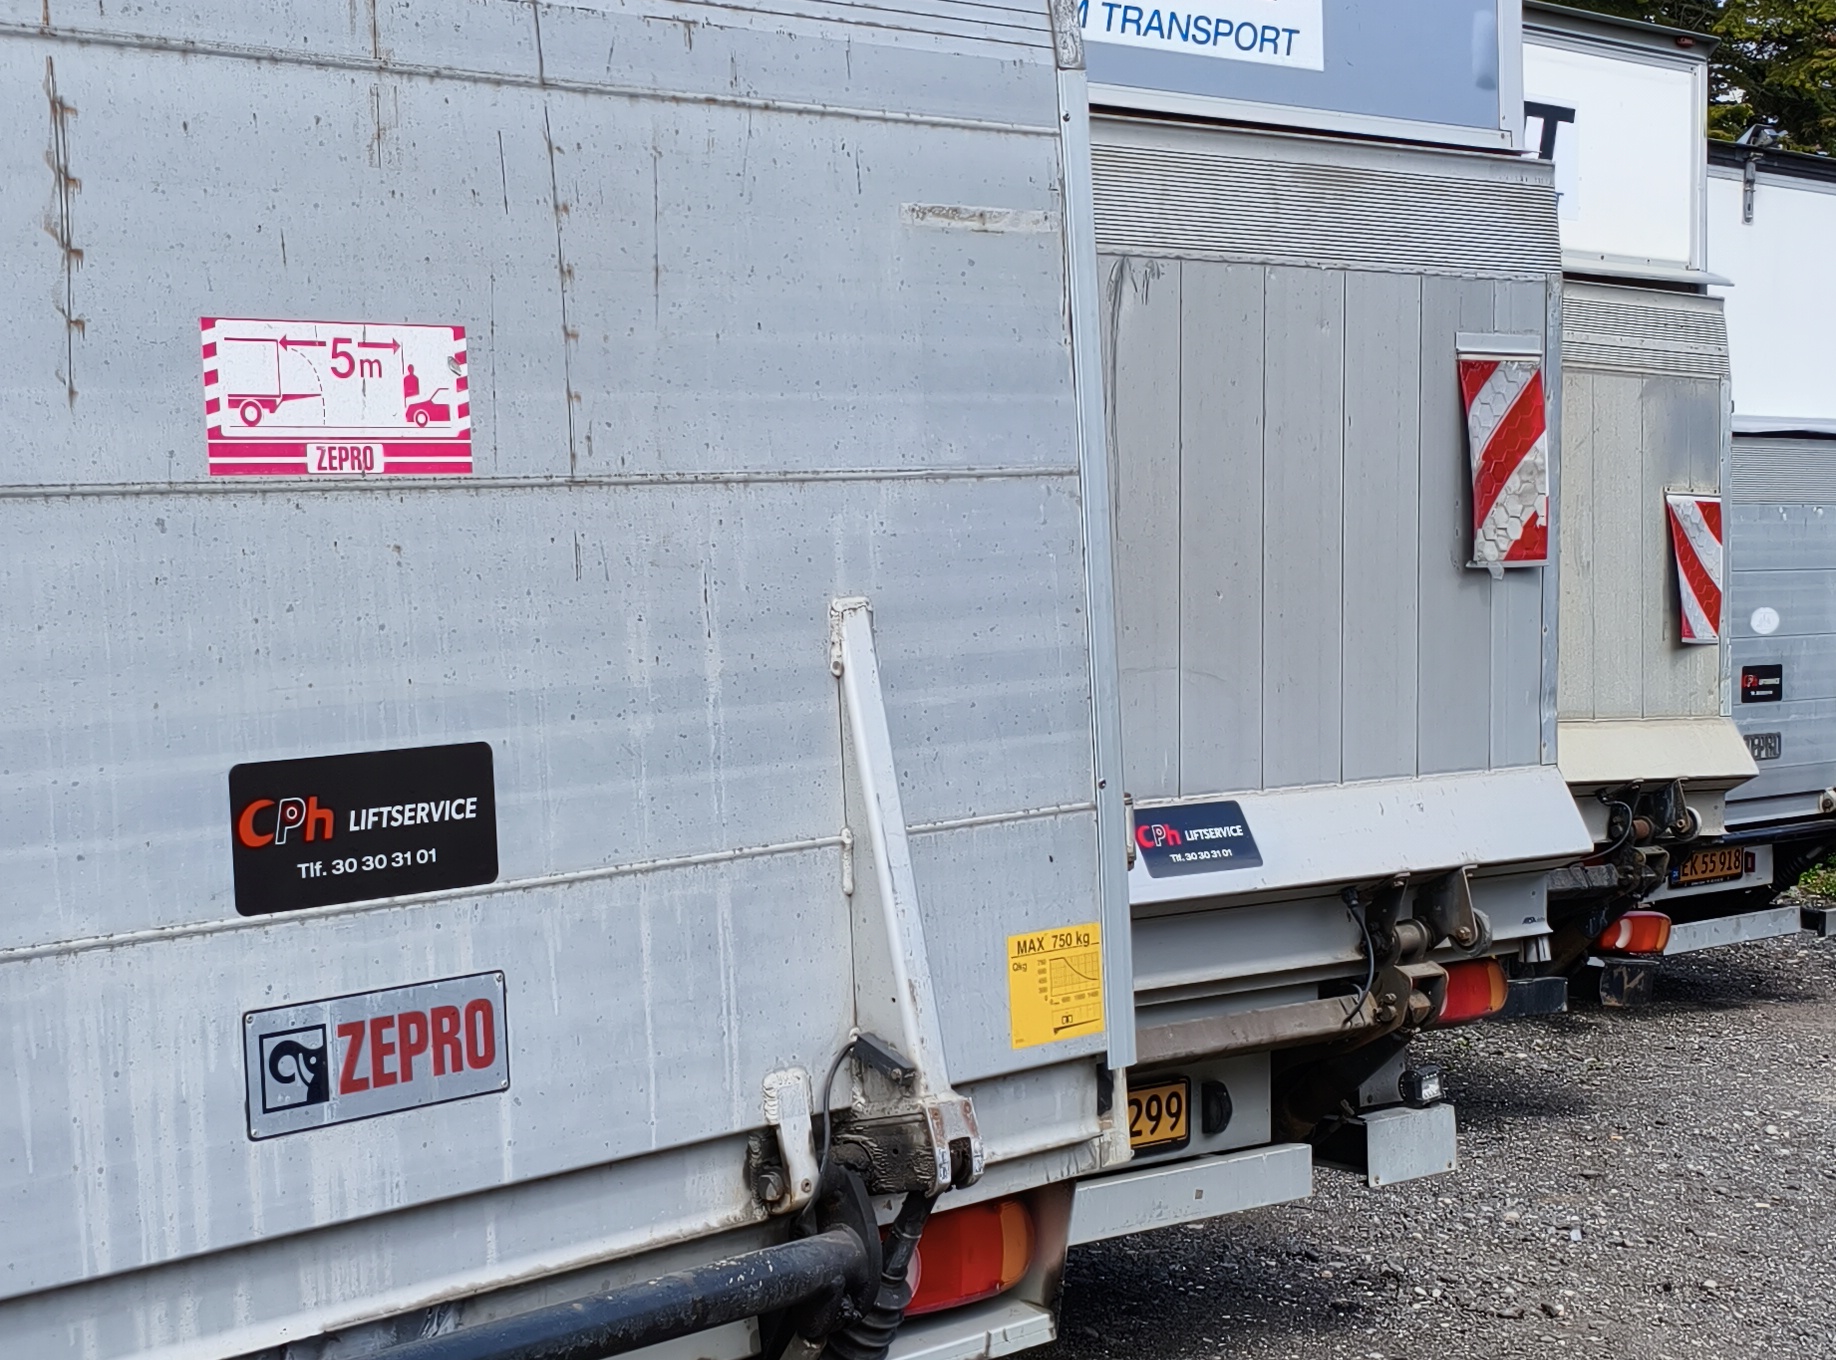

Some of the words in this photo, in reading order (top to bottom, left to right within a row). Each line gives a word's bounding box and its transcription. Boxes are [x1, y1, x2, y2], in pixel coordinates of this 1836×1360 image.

[1101, 1, 1301, 57] TRANSPORT
[315, 445, 375, 473] ZEPRO
[348, 796, 478, 833] LIFTSERVICE
[1184, 824, 1244, 842] LIFTSERVICE
[297, 860, 328, 880] Tlf.
[331, 857, 358, 875] 30
[361, 853, 388, 872] 30
[391, 850, 412, 869] 31
[416, 847, 438, 865] 01
[1185, 851, 1198, 862] 30
[1198, 850, 1211, 861] 30
[1211, 849, 1222, 860] 31
[1222, 848, 1233, 858] 01
[1701, 852, 1717, 875] 55
[1719, 848, 1741, 872] 918
[1016, 936, 1045, 955] MAX
[1051, 932, 1073, 949] 750
[1076, 931, 1091, 948] kg
[336, 997, 497, 1096] ZEPRO
